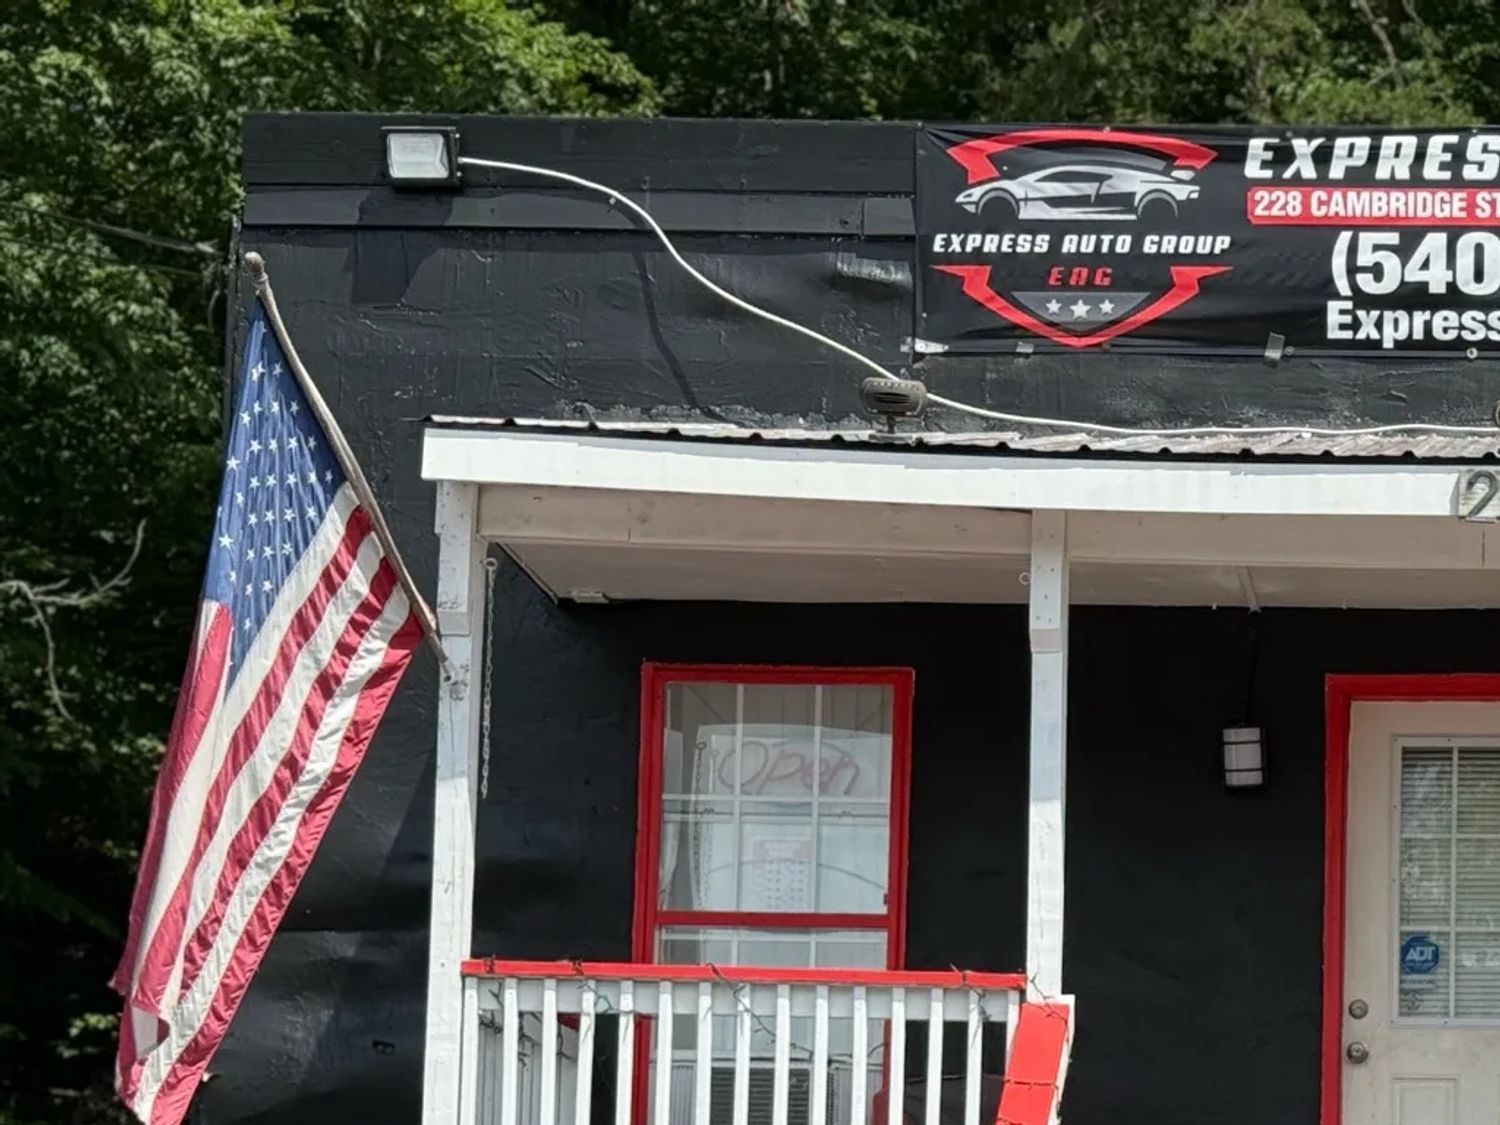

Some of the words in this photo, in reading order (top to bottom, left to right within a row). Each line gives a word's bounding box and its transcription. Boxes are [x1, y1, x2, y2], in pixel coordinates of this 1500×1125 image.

[1254, 190, 1302, 217] 228
[1310, 191, 1467, 218] CAMBRIDGE
[933, 232, 1050, 255] EXPRESS
[1061, 234, 1132, 255] AUTO
[1142, 235, 1232, 255] GROUP
[1047, 266, 1113, 287] EAG
[1405, 946, 1436, 962] ADT
